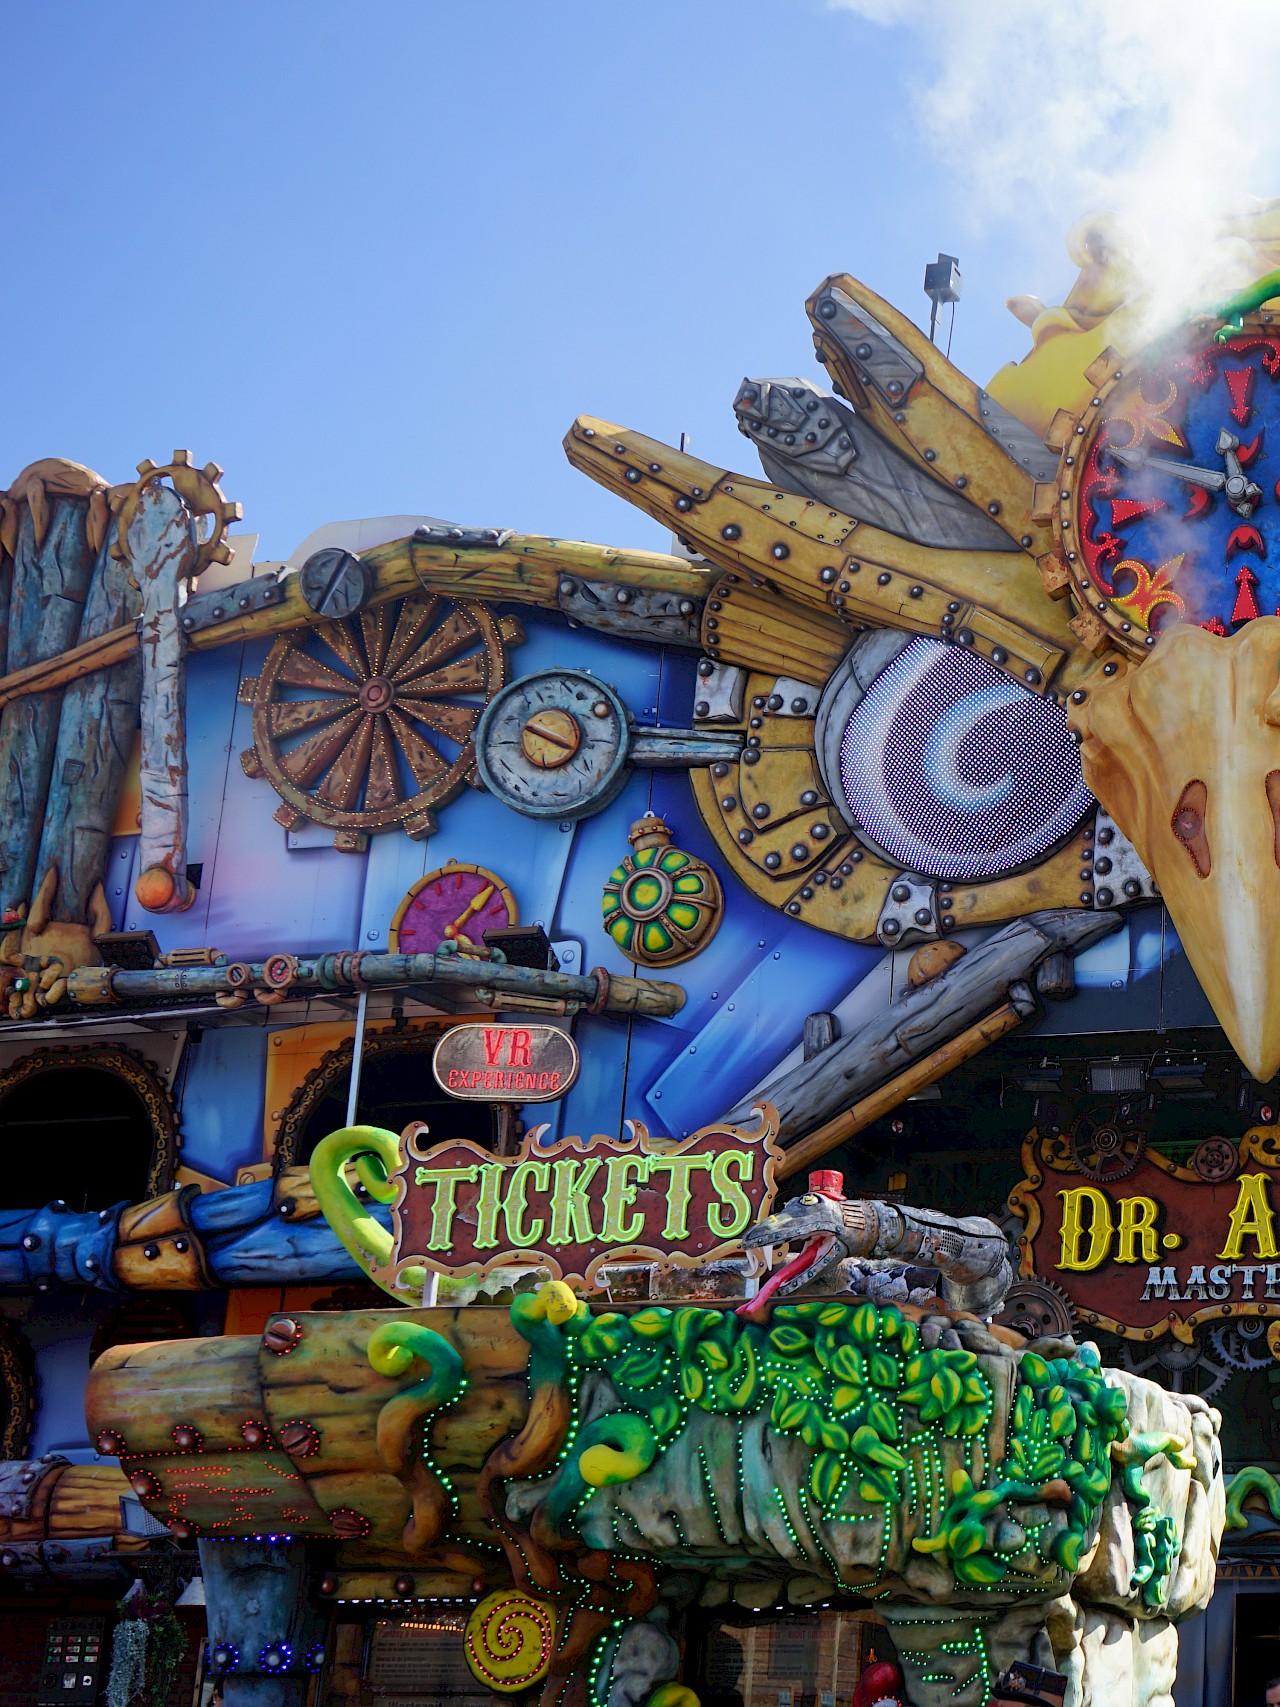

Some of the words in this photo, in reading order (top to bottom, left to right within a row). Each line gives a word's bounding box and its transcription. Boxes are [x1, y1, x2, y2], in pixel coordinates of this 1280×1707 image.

[482, 1028, 533, 1067] VR
[448, 1069, 561, 1090] EXPERIENCE
[415, 1149, 755, 1252] TICKETS
[1055, 1186, 1183, 1271] DR.
